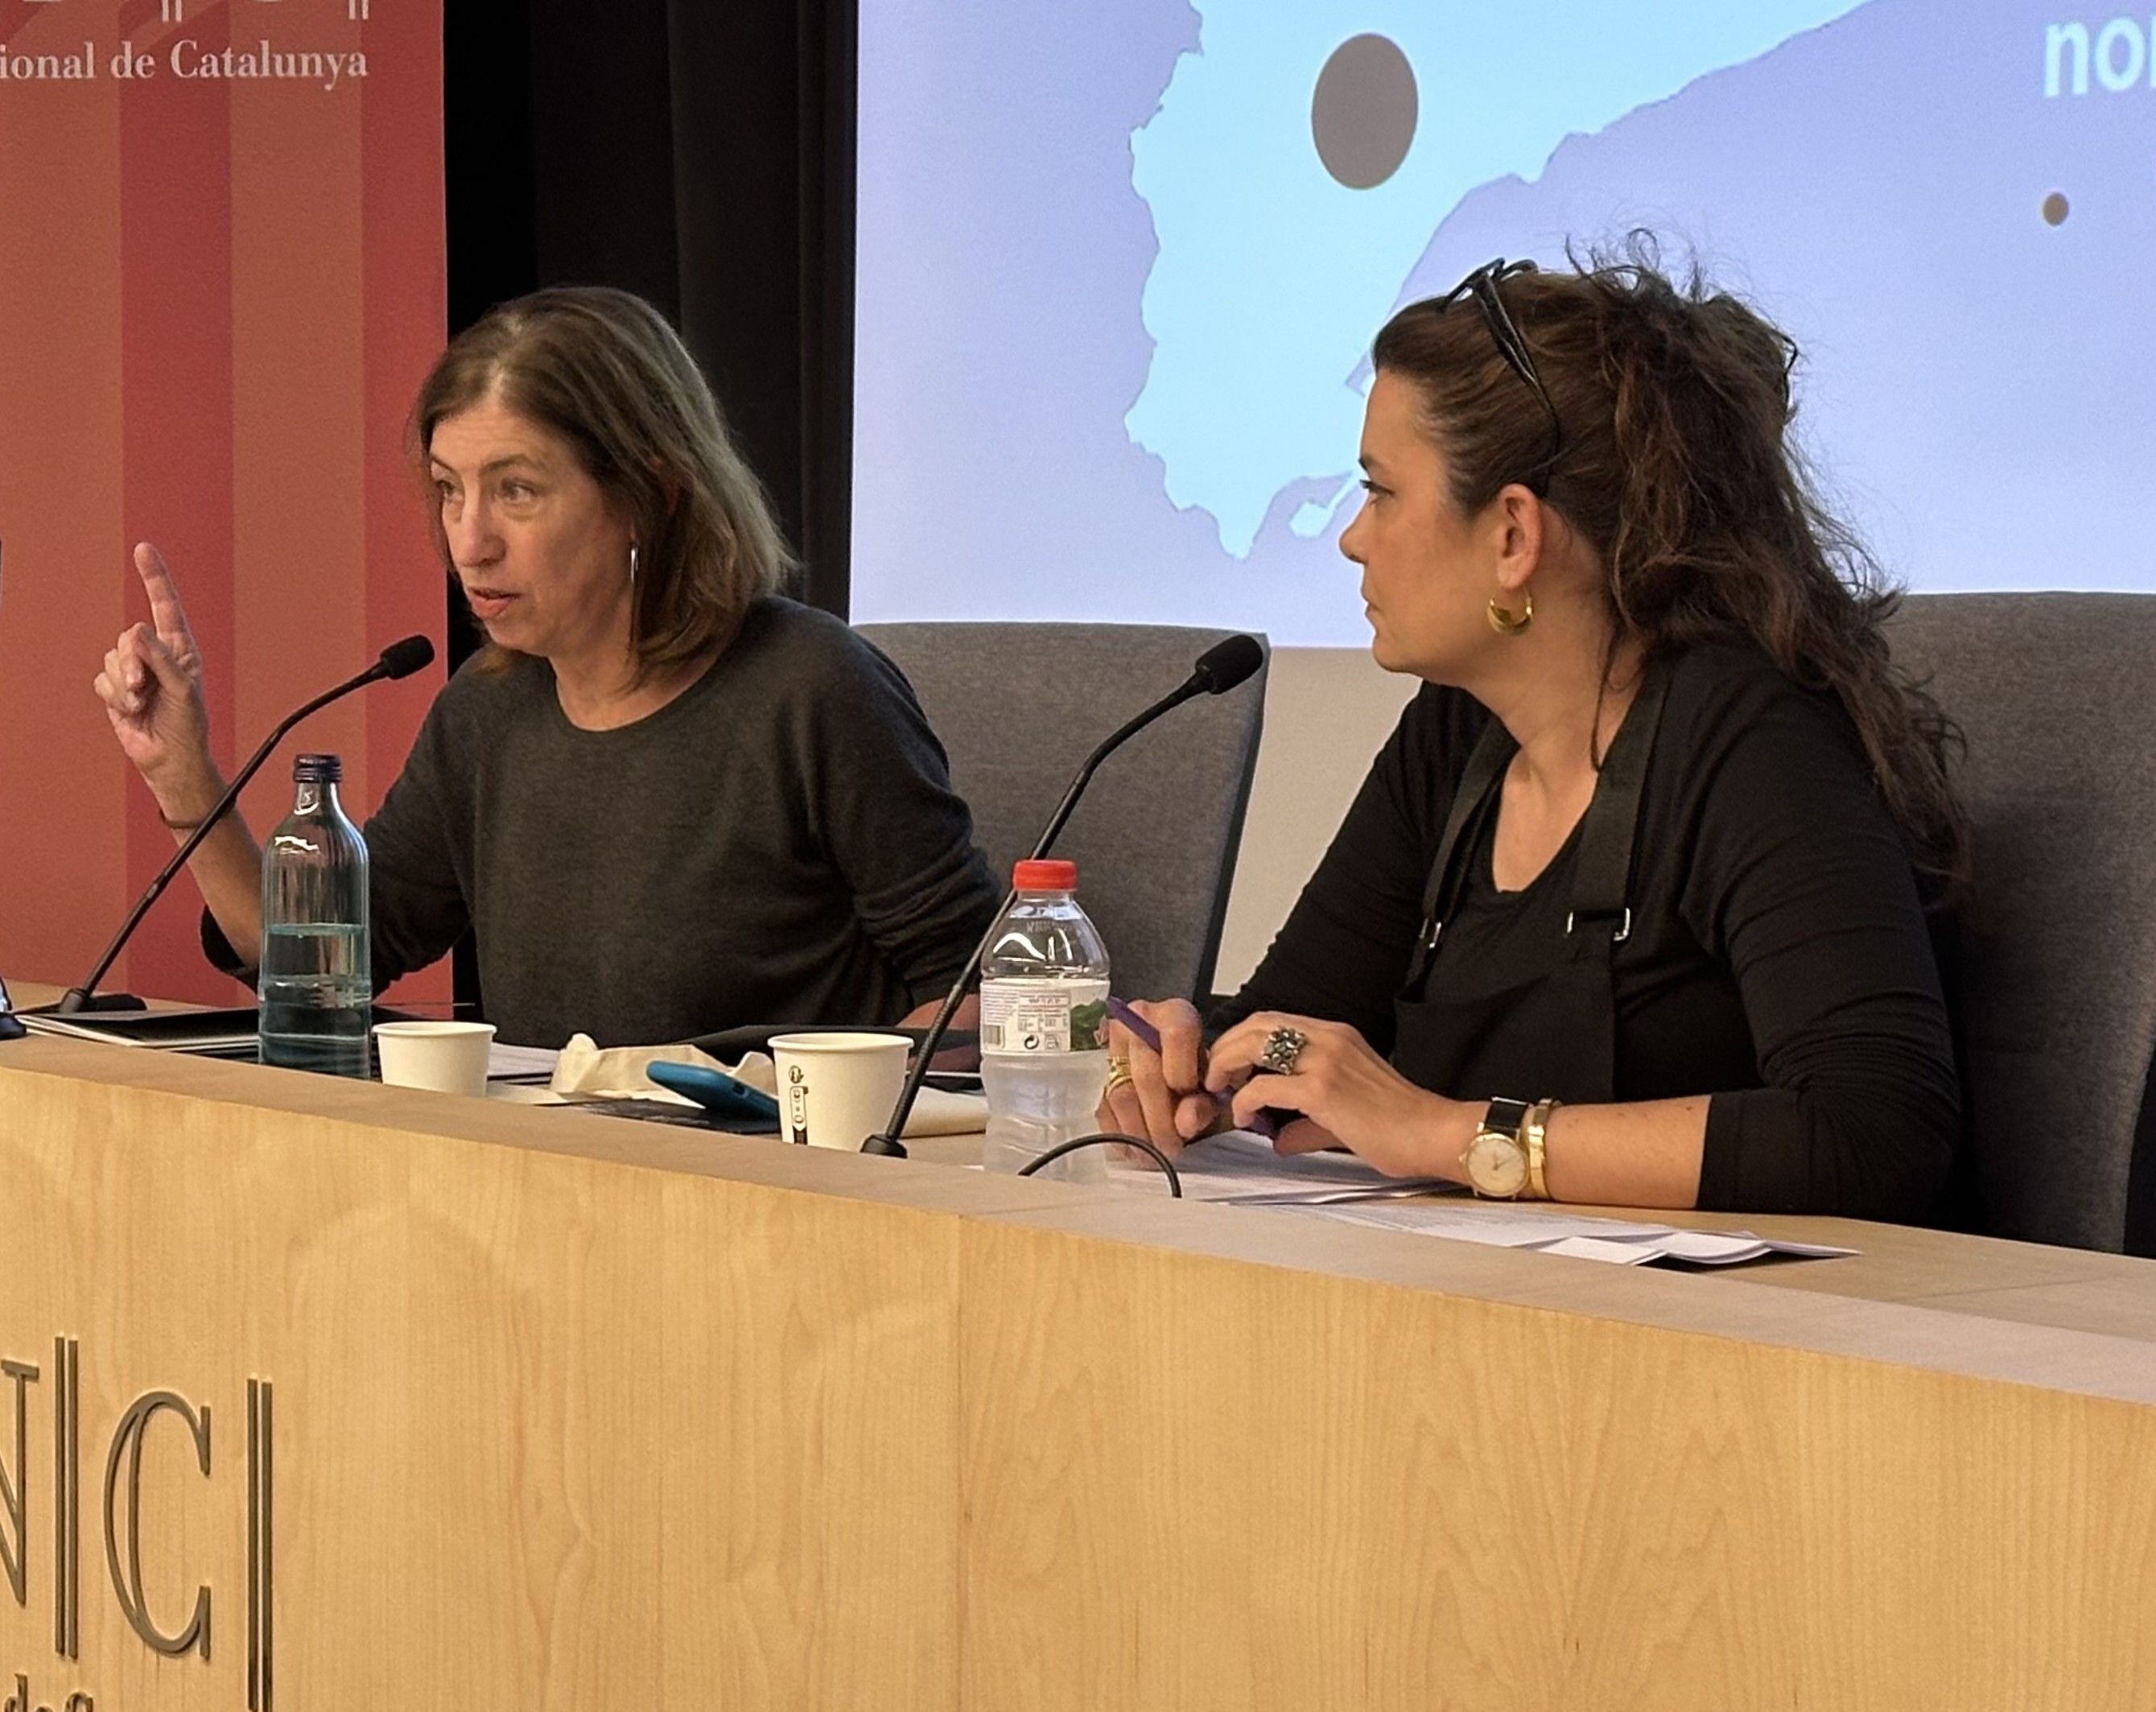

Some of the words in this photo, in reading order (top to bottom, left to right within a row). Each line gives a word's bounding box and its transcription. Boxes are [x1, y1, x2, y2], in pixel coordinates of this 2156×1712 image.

[111, 41, 155, 79] de
[171, 39, 368, 90] Catalunya
[2045, 15, 2156, 97] no
